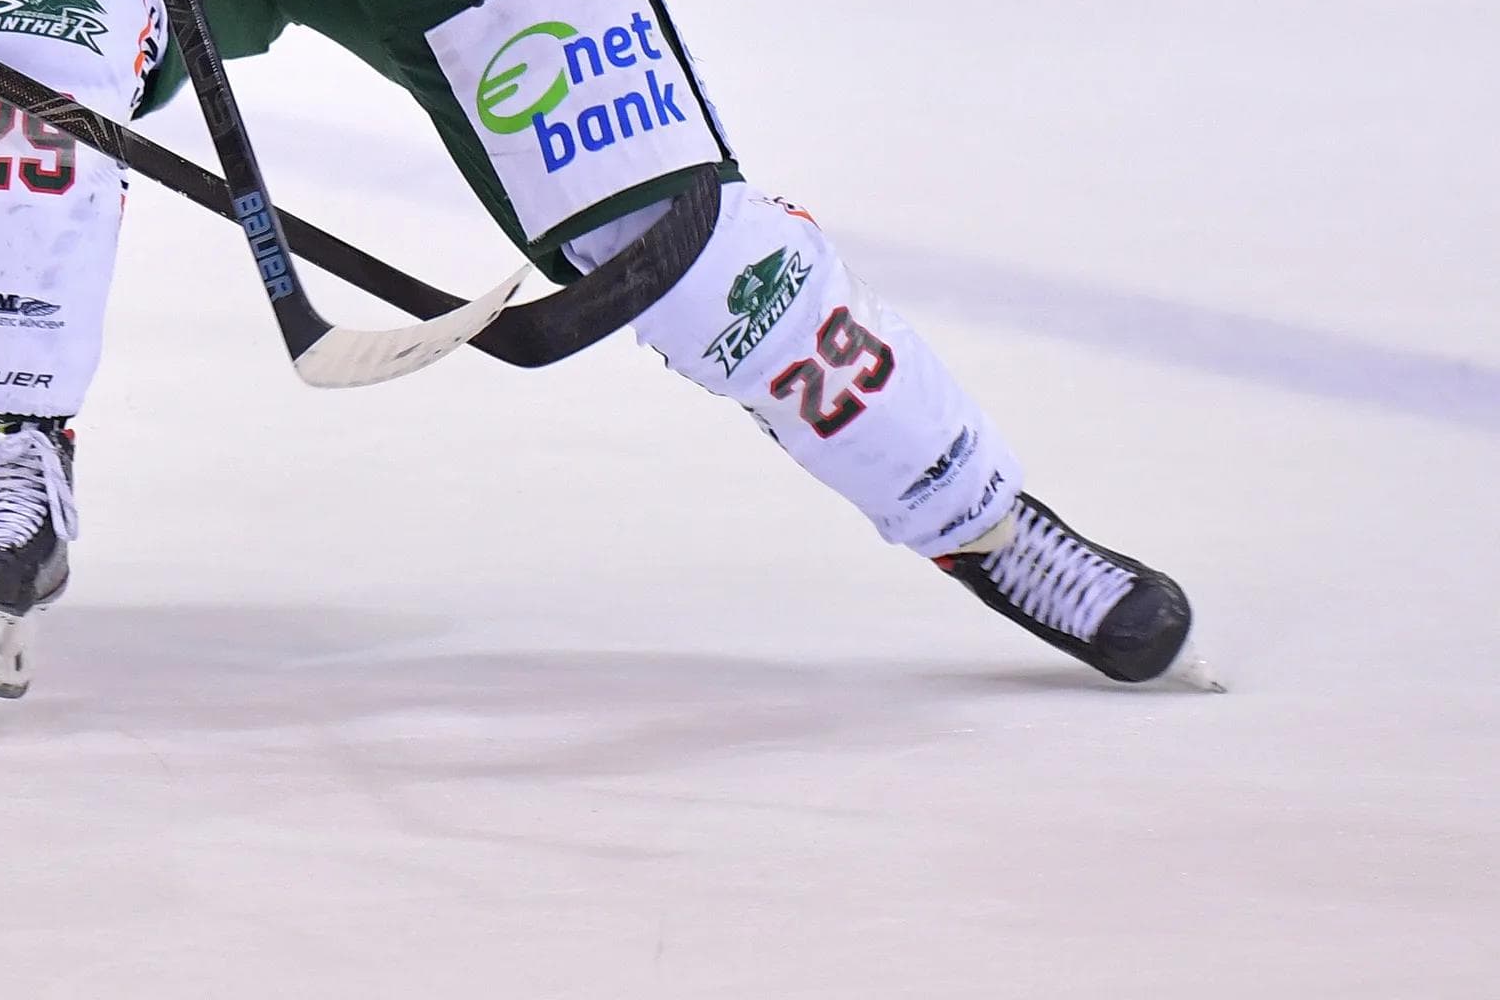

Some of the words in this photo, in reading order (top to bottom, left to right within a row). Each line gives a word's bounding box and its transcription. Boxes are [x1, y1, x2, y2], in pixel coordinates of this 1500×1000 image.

[563, 12, 663, 85] net
[532, 70, 687, 174] bank
[233, 191, 295, 302] BAUER
[701, 250, 814, 381] PANTHER
[769, 305, 896, 440] 29
